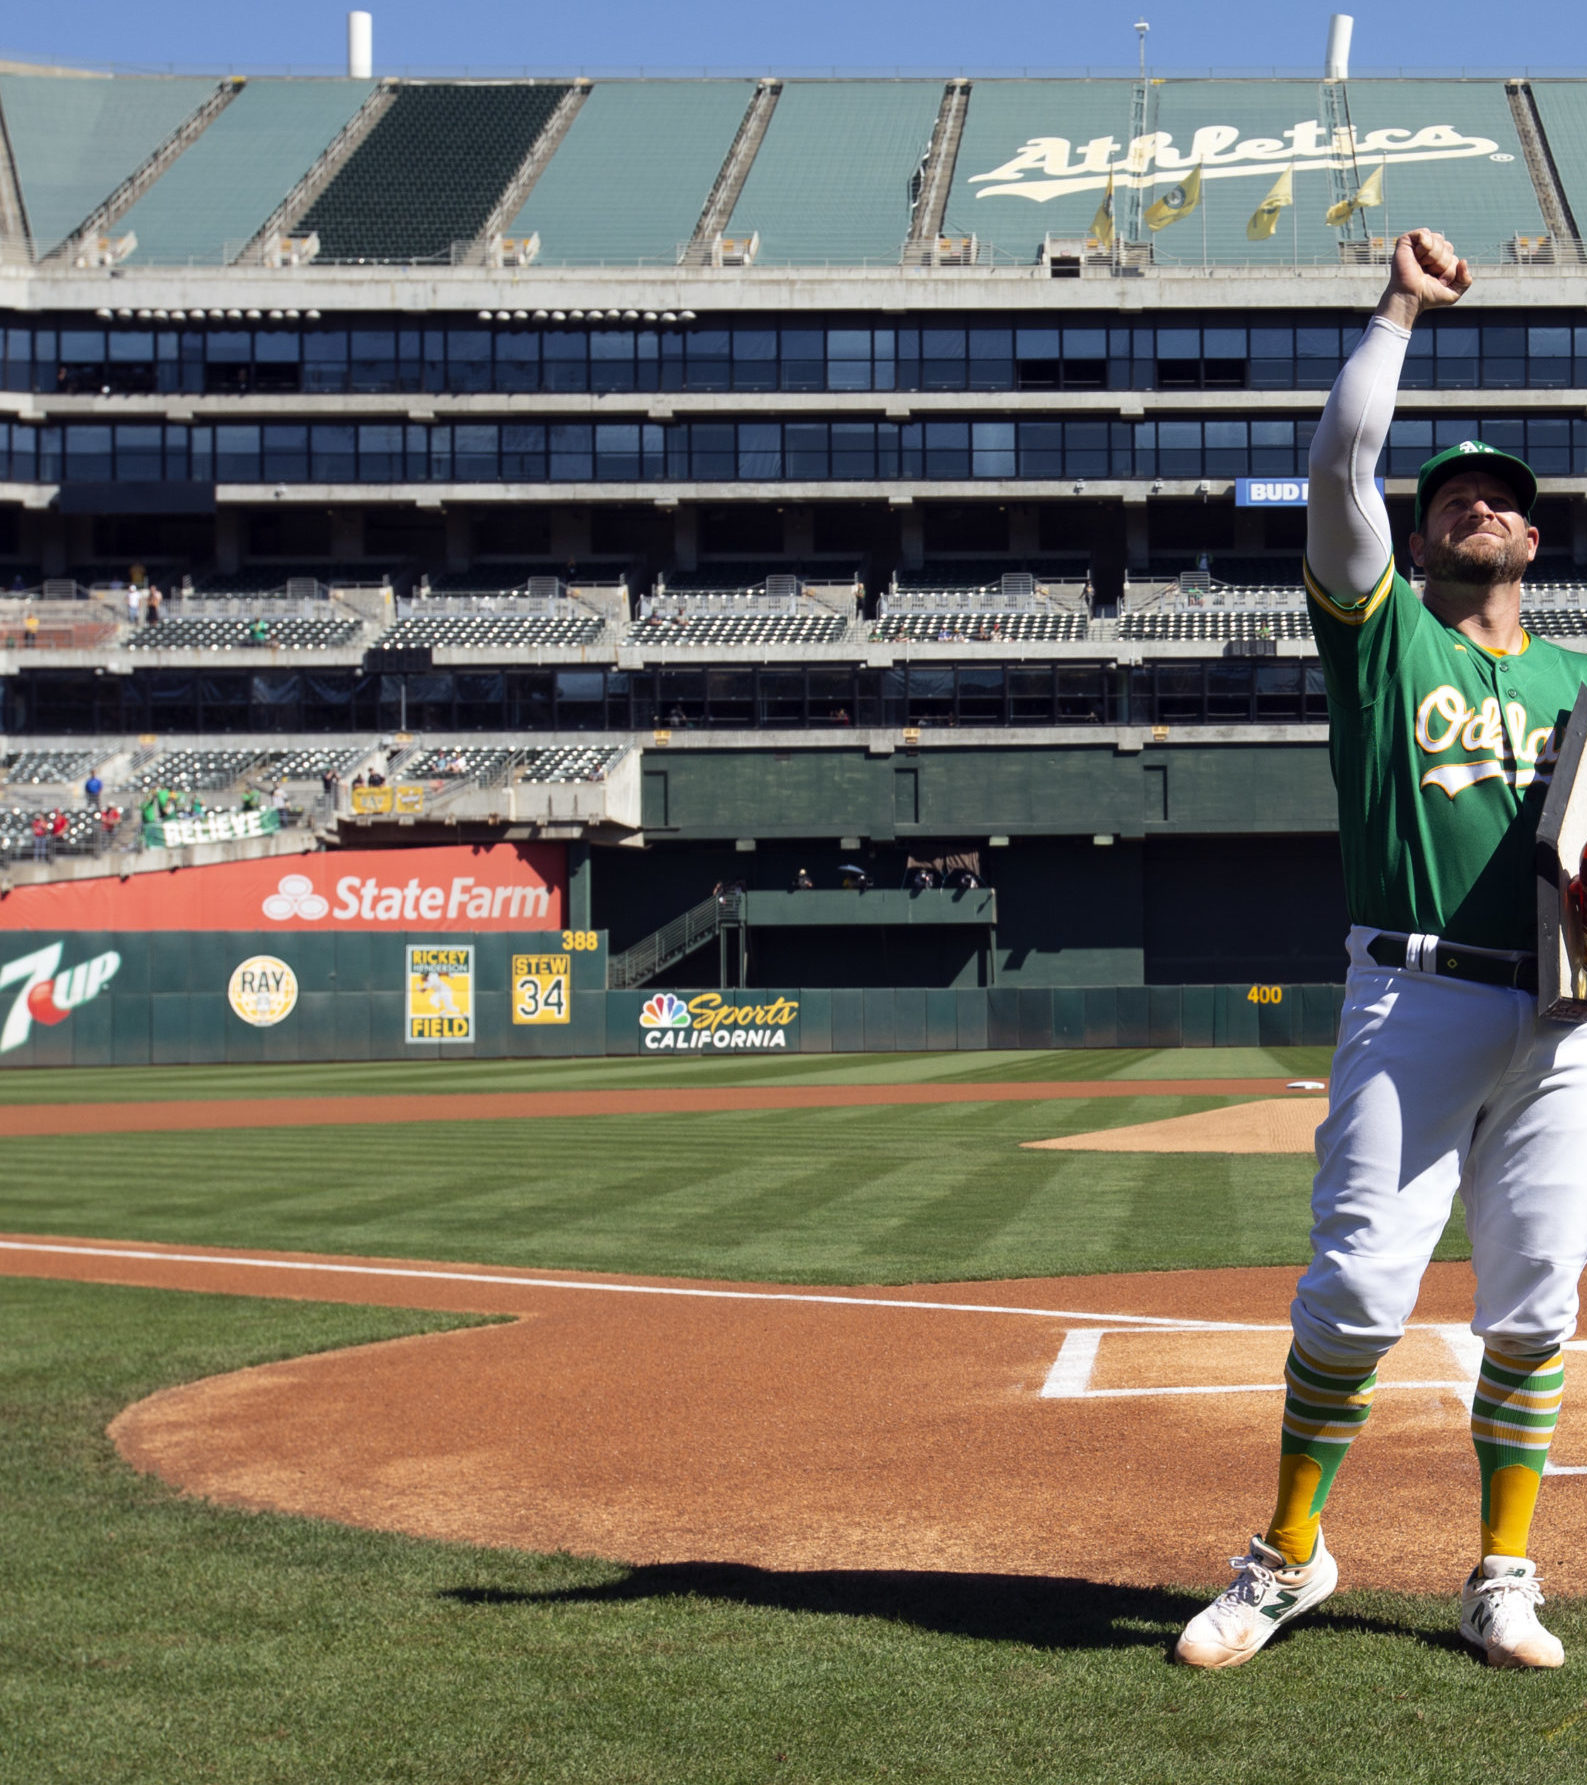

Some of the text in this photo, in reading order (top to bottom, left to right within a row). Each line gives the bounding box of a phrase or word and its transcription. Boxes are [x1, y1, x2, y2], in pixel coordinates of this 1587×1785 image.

[968, 119, 1498, 184] Athletics
[1250, 483, 1300, 501] BUD
[162, 810, 263, 848] BELIEVE
[562, 931, 598, 951] 388
[412, 950, 468, 965] RICKEY
[516, 958, 568, 974] STEW
[241, 971, 285, 993] RAY
[0, 940, 64, 1052] 7
[518, 978, 566, 1017] 34
[1247, 985, 1282, 1004] 400
[688, 993, 799, 1033] Sports
[412, 1019, 469, 1038] FIELD
[645, 1029, 786, 1049] CALIFORNIA
